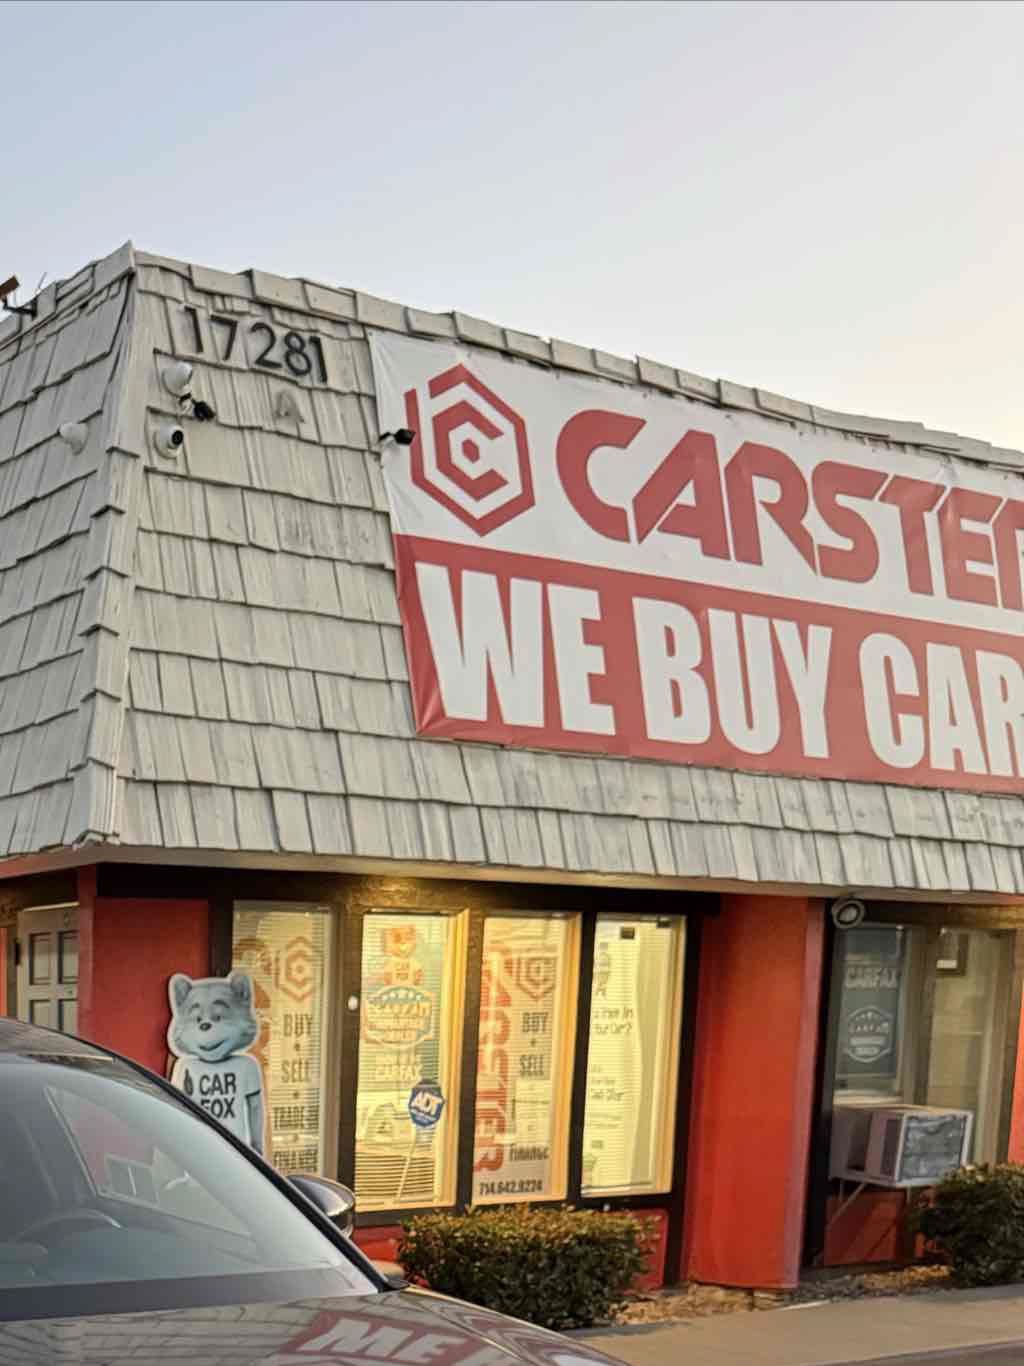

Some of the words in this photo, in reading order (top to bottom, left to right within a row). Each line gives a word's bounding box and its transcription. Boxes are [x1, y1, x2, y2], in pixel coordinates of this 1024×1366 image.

[184, 305, 328, 384] 17281
[414, 561, 616, 736] WE
[631, 596, 833, 761] BUY
[283, 1014, 313, 1037] BUY
[281, 1059, 312, 1083] SELL
[199, 1072, 237, 1096] CAR
[200, 1097, 236, 1119] FOX
